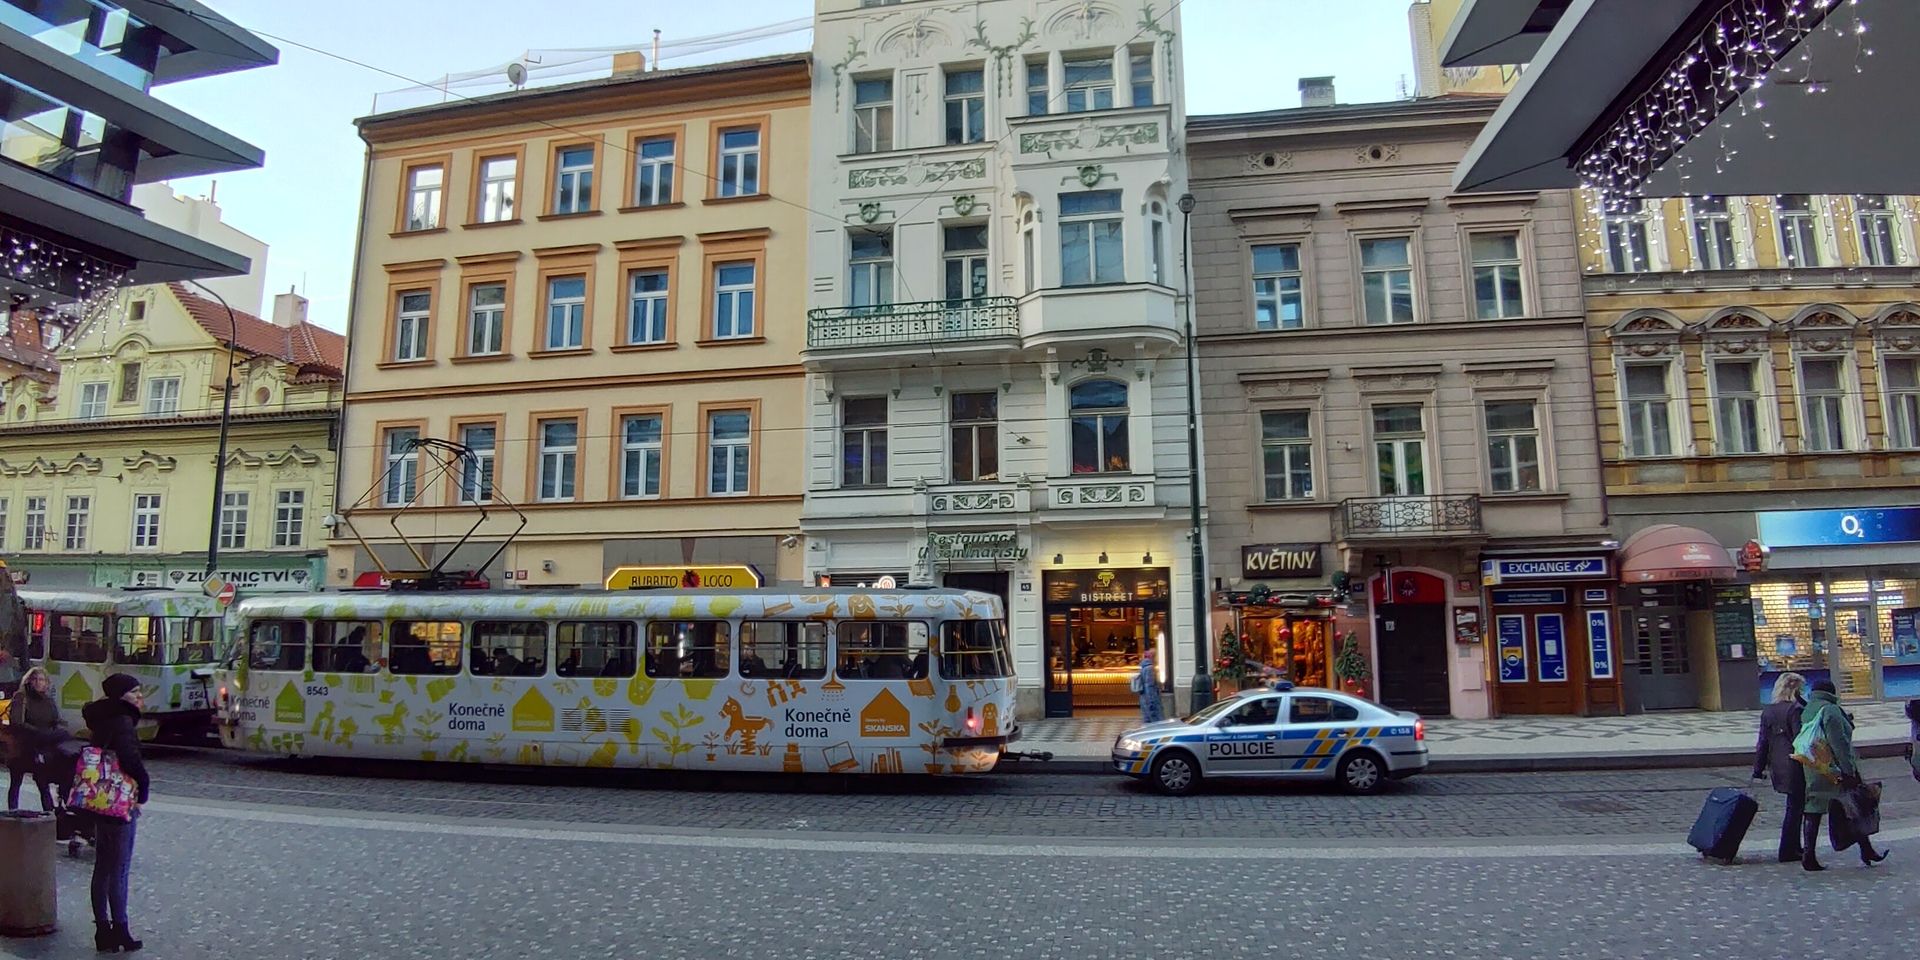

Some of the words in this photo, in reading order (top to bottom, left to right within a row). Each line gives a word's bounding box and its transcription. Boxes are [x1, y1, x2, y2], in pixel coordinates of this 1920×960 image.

[1841, 515, 1865, 538] O2
[1246, 547, 1316, 570] KVĚTINY
[1508, 561, 1572, 573] EXCHANGE
[186, 568, 289, 582] ZLTNICTVÍ
[703, 574, 733, 588] LOCO
[1081, 592, 1133, 602] BISTREET
[1591, 619, 1605, 627] 0%
[188, 649, 203, 661] 22
[1594, 660, 1608, 669] 0%
[188, 691, 206, 700] 854
[306, 686, 329, 696] 8543
[448, 702, 505, 717] Konečně
[785, 708, 852, 722] Konečně
[448, 717, 486, 731] doma
[784, 723, 829, 738] doma
[864, 724, 906, 733] SKANSKA
[1209, 741, 1275, 756] POLICIE
